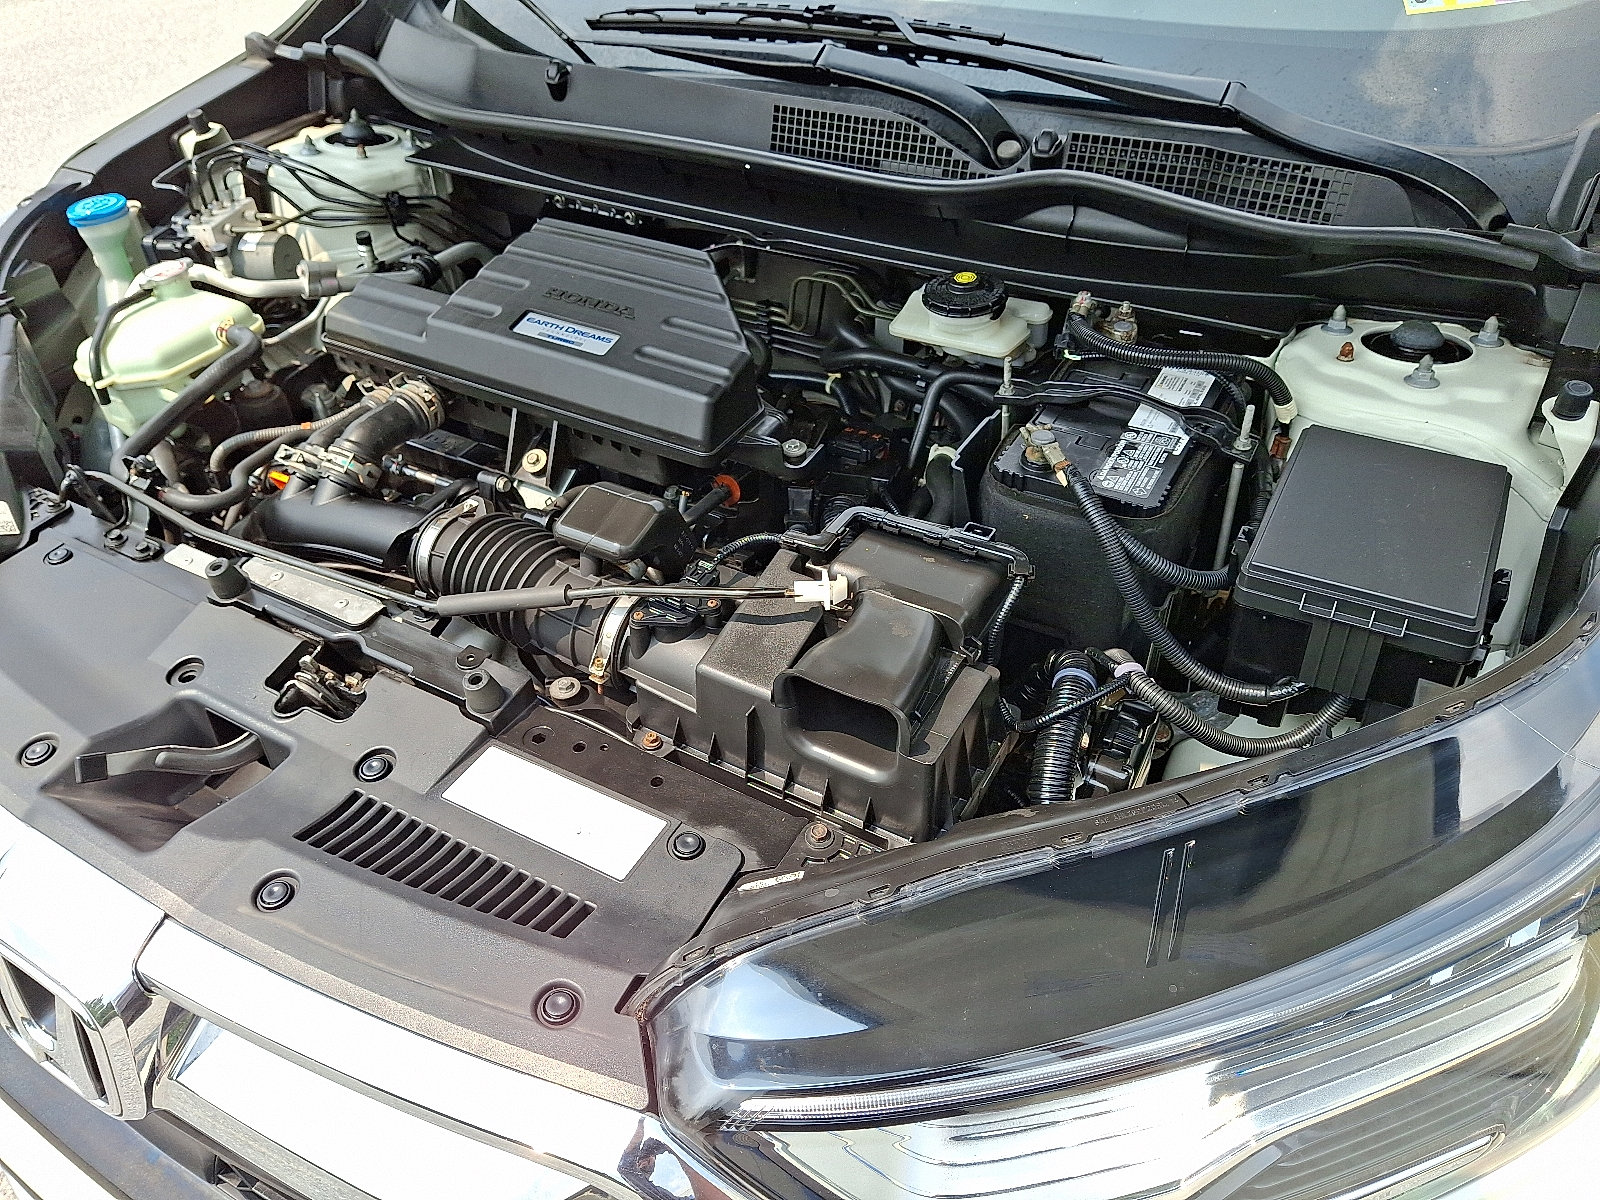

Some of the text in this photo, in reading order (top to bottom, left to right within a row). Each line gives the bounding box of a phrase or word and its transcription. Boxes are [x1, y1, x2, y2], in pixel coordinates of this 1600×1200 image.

[542, 287, 636, 320] HONDA
[526, 317, 565, 331] EARTH
[565, 326, 614, 344] DREAMS
